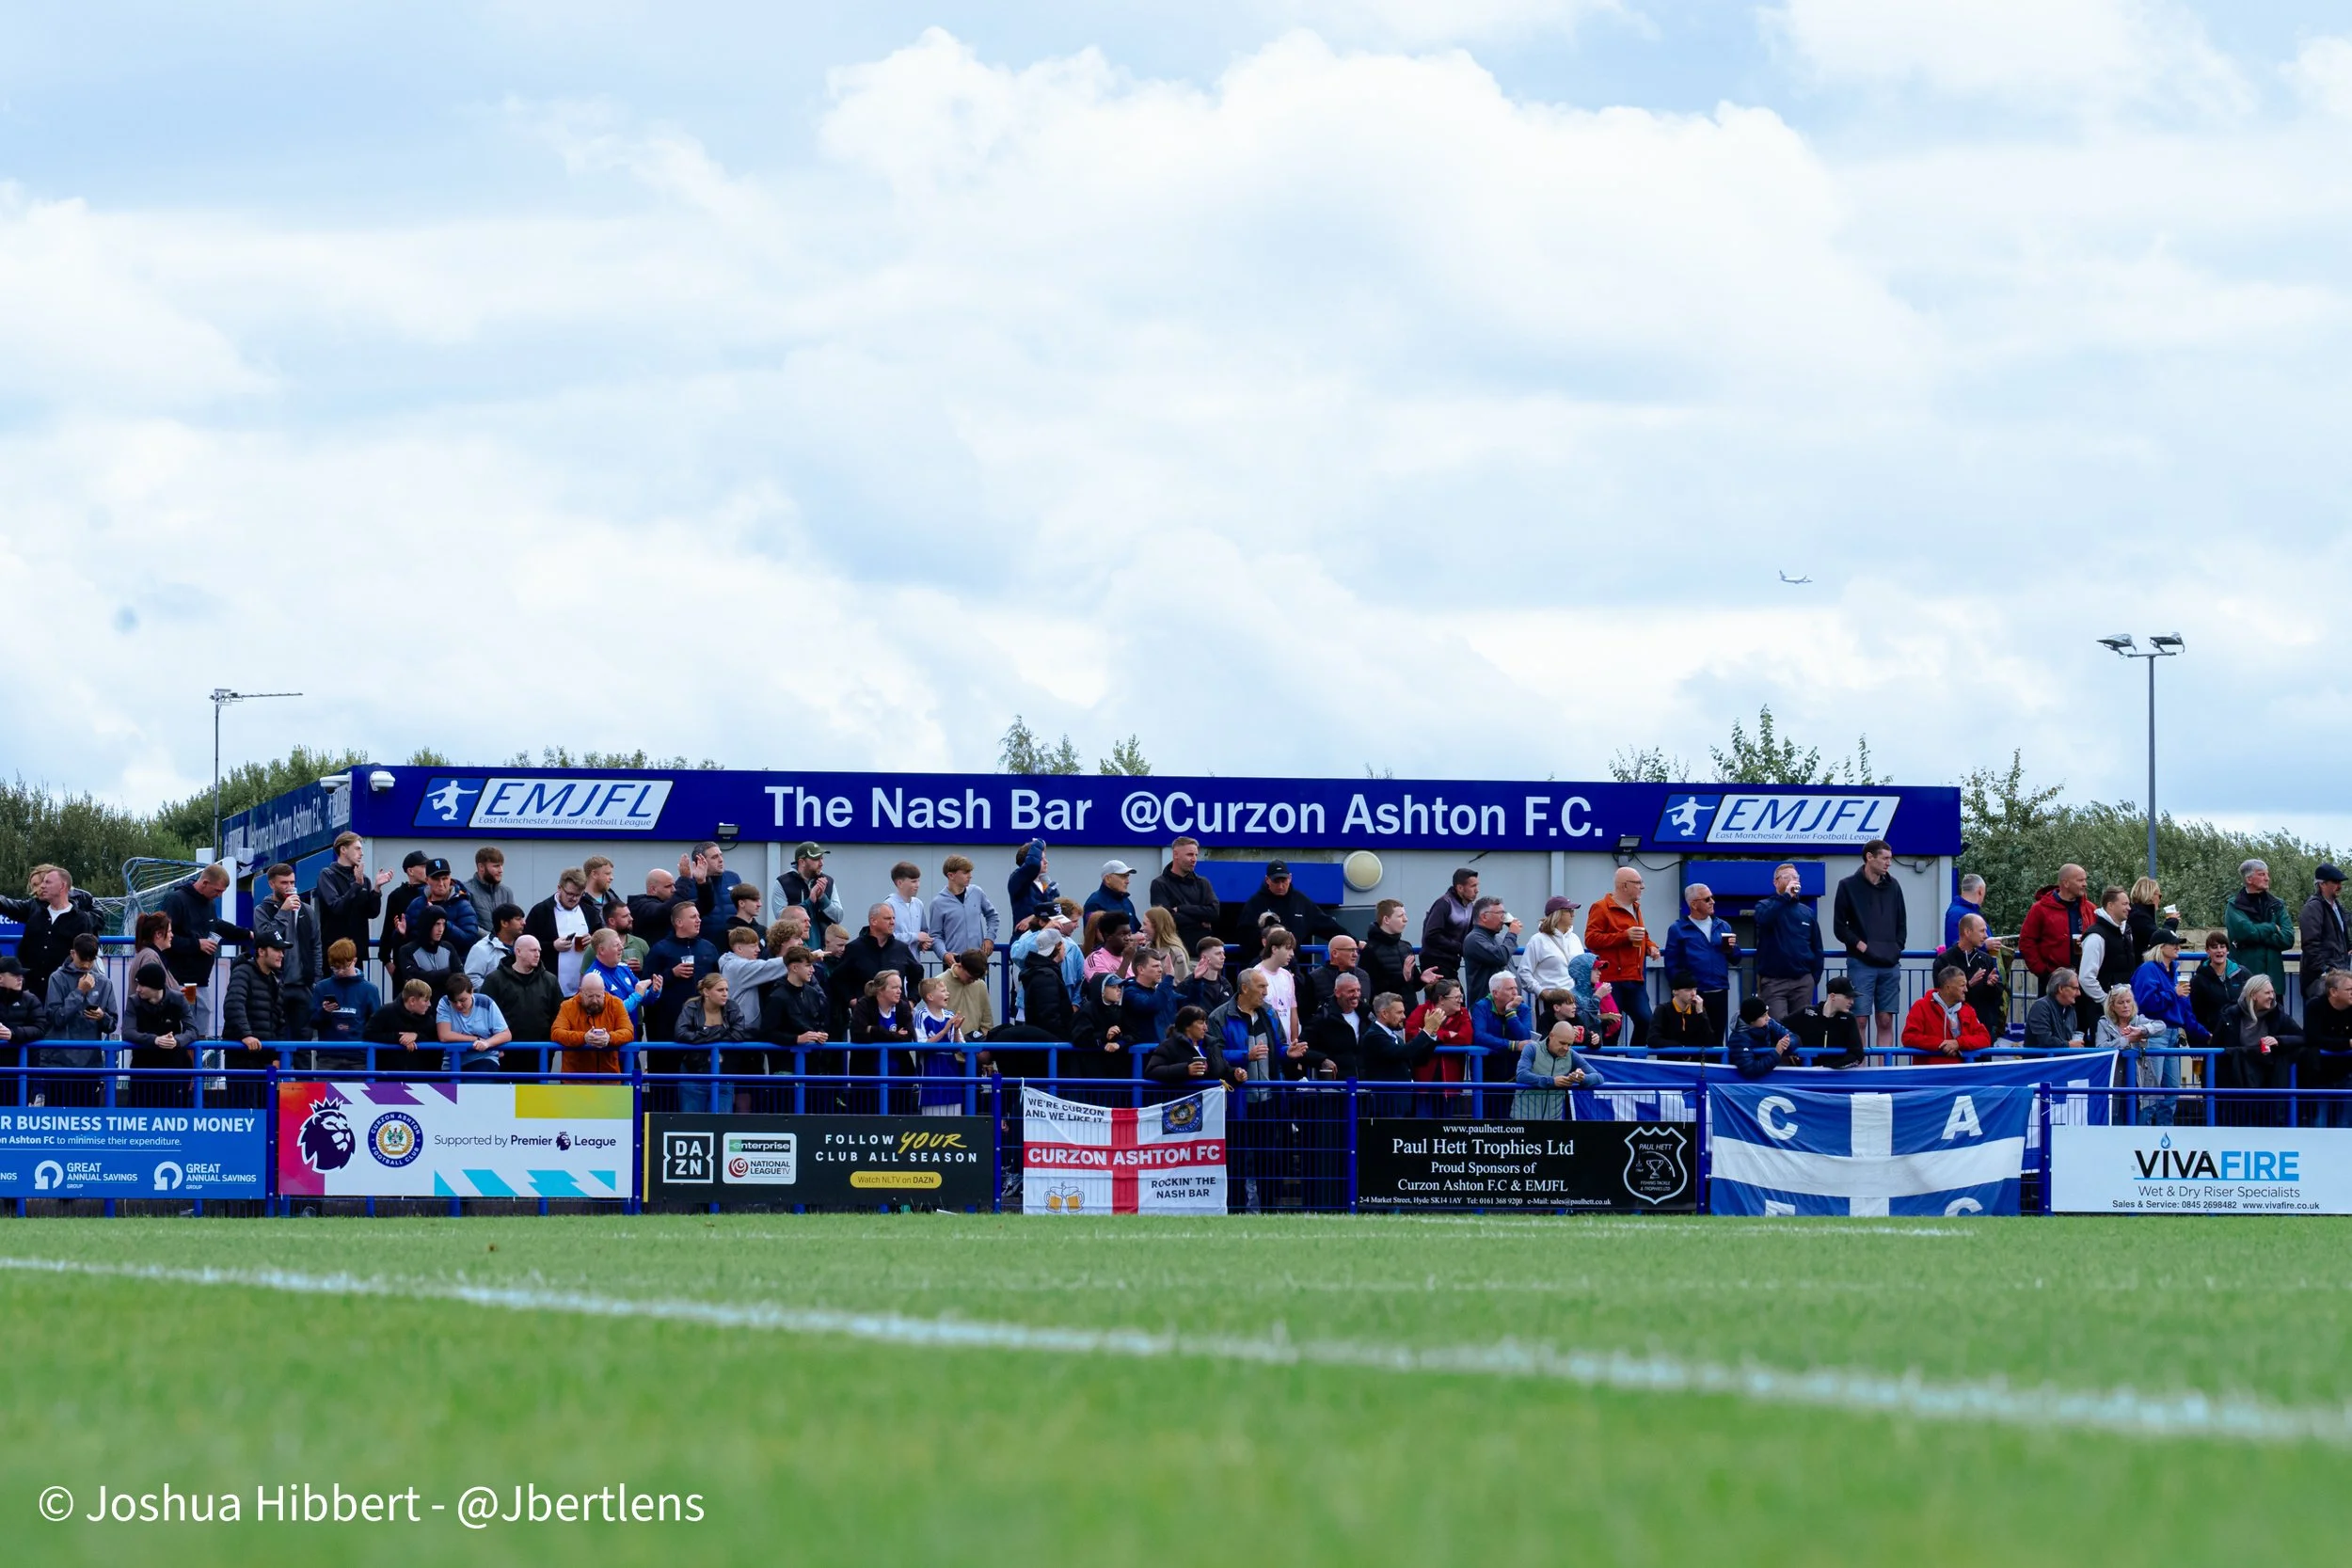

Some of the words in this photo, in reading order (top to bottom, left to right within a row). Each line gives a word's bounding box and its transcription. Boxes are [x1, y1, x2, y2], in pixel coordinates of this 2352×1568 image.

[485, 783, 652, 817] EMJFL
[765, 786, 853, 827] The
[872, 787, 991, 829] Nash
[1011, 789, 1091, 830] Bar
[1121, 788, 1325, 833] @Curzon
[1342, 794, 1505, 835] Ashton
[1526, 797, 1603, 837] F.C.
[1721, 799, 1880, 832] EMJFL
[275, 813, 292, 847] Curzon
[293, 803, 312, 840] Ashton
[499, 816, 548, 825] Manchester
[551, 817, 578, 826] Junior
[619, 818, 652, 828] League
[1850, 833, 1880, 842] League
[1028, 1098, 1058, 1109] WE'RE
[1062, 1104, 1104, 1117] CURZON
[1025, 1109, 1046, 1118] AND
[1049, 1112, 1065, 1121] WE
[1068, 1114, 1090, 1122] LIKE
[1756, 1095, 1799, 1140] C
[1941, 1095, 1983, 1140] A
[17, 1116, 102, 1131] BUSINESS
[106, 1117, 148, 1131] TIME
[151, 1117, 188, 1132] AND
[193, 1117, 255, 1132] MONEY
[371, 1114, 395, 1134] CURZON
[397, 1114, 421, 1134] ASHTON
[1442, 1124, 1525, 1134] www.paulhett.com
[8, 1135, 41, 1145] Ashton
[43, 1136, 55, 1145] FC
[56, 1136, 66, 1145] to
[68, 1135, 105, 1146] minimise
[107, 1136, 127, 1146] their
[129, 1137, 183, 1148] expenditure.
[434, 1135, 492, 1148] Supported
[494, 1135, 508, 1148] by
[511, 1135, 553, 1147] Premier
[575, 1136, 617, 1148] League
[733, 1141, 790, 1151] enterprise
[825, 1134, 895, 1145] FOLLOW
[898, 1131, 967, 1154] YOUR
[1028, 1148, 1107, 1165] CURZON
[1113, 1147, 1191, 1165] ASHTON
[1197, 1145, 1220, 1161] FC
[1392, 1138, 1427, 1155] Paul
[1433, 1139, 1468, 1155] Hett
[1471, 1139, 1542, 1159] Trophies
[1548, 1139, 1575, 1156] Ltd
[372, 1147, 404, 1165] FOOTBALL
[405, 1147, 420, 1163] CLUB
[815, 1151, 858, 1162] CLUB
[868, 1151, 898, 1162] ALL
[910, 1152, 977, 1163] SEASON
[67, 1163, 102, 1173] GREAT
[186, 1164, 221, 1174] GREAT
[1431, 1161, 1465, 1174] Proud
[1468, 1162, 1520, 1178] Sponsors
[1523, 1162, 1537, 1175] of
[2135, 1149, 2299, 1180] VIVAFIRE
[186, 1174, 221, 1182] ANNUAL
[857, 1176, 881, 1184] Watch
[1152, 1178, 1193, 1189] ROCKIN'
[1196, 1177, 1216, 1186] THE
[1398, 1179, 1440, 1191] Curzon
[1443, 1179, 1485, 1191] Ashton
[1487, 1180, 1507, 1192] F.C
[1510, 1180, 1521, 1192] &
[1525, 1180, 1568, 1193] EMJFL
[2137, 1186, 2164, 1197] Wet
[2167, 1186, 2176, 1197] &
[2178, 1186, 2201, 1199] Dry
[2204, 1186, 2234, 1197] Riser
[2237, 1186, 2300, 1199] Specialists
[1156, 1190, 1185, 1199] NASH
[1188, 1189, 1210, 1198] BAR
[1413, 1196, 1430, 1205] Hyde
[2112, 1200, 2137, 1209] Sales
[2137, 1200, 2144, 1209] &
[2146, 1200, 2180, 1209] Service:
[2181, 1200, 2201, 1209] 0845
[2203, 1200, 2237, 1210] 2698482
[2243, 1201, 2320, 1210] www.vivafire.co.uk
